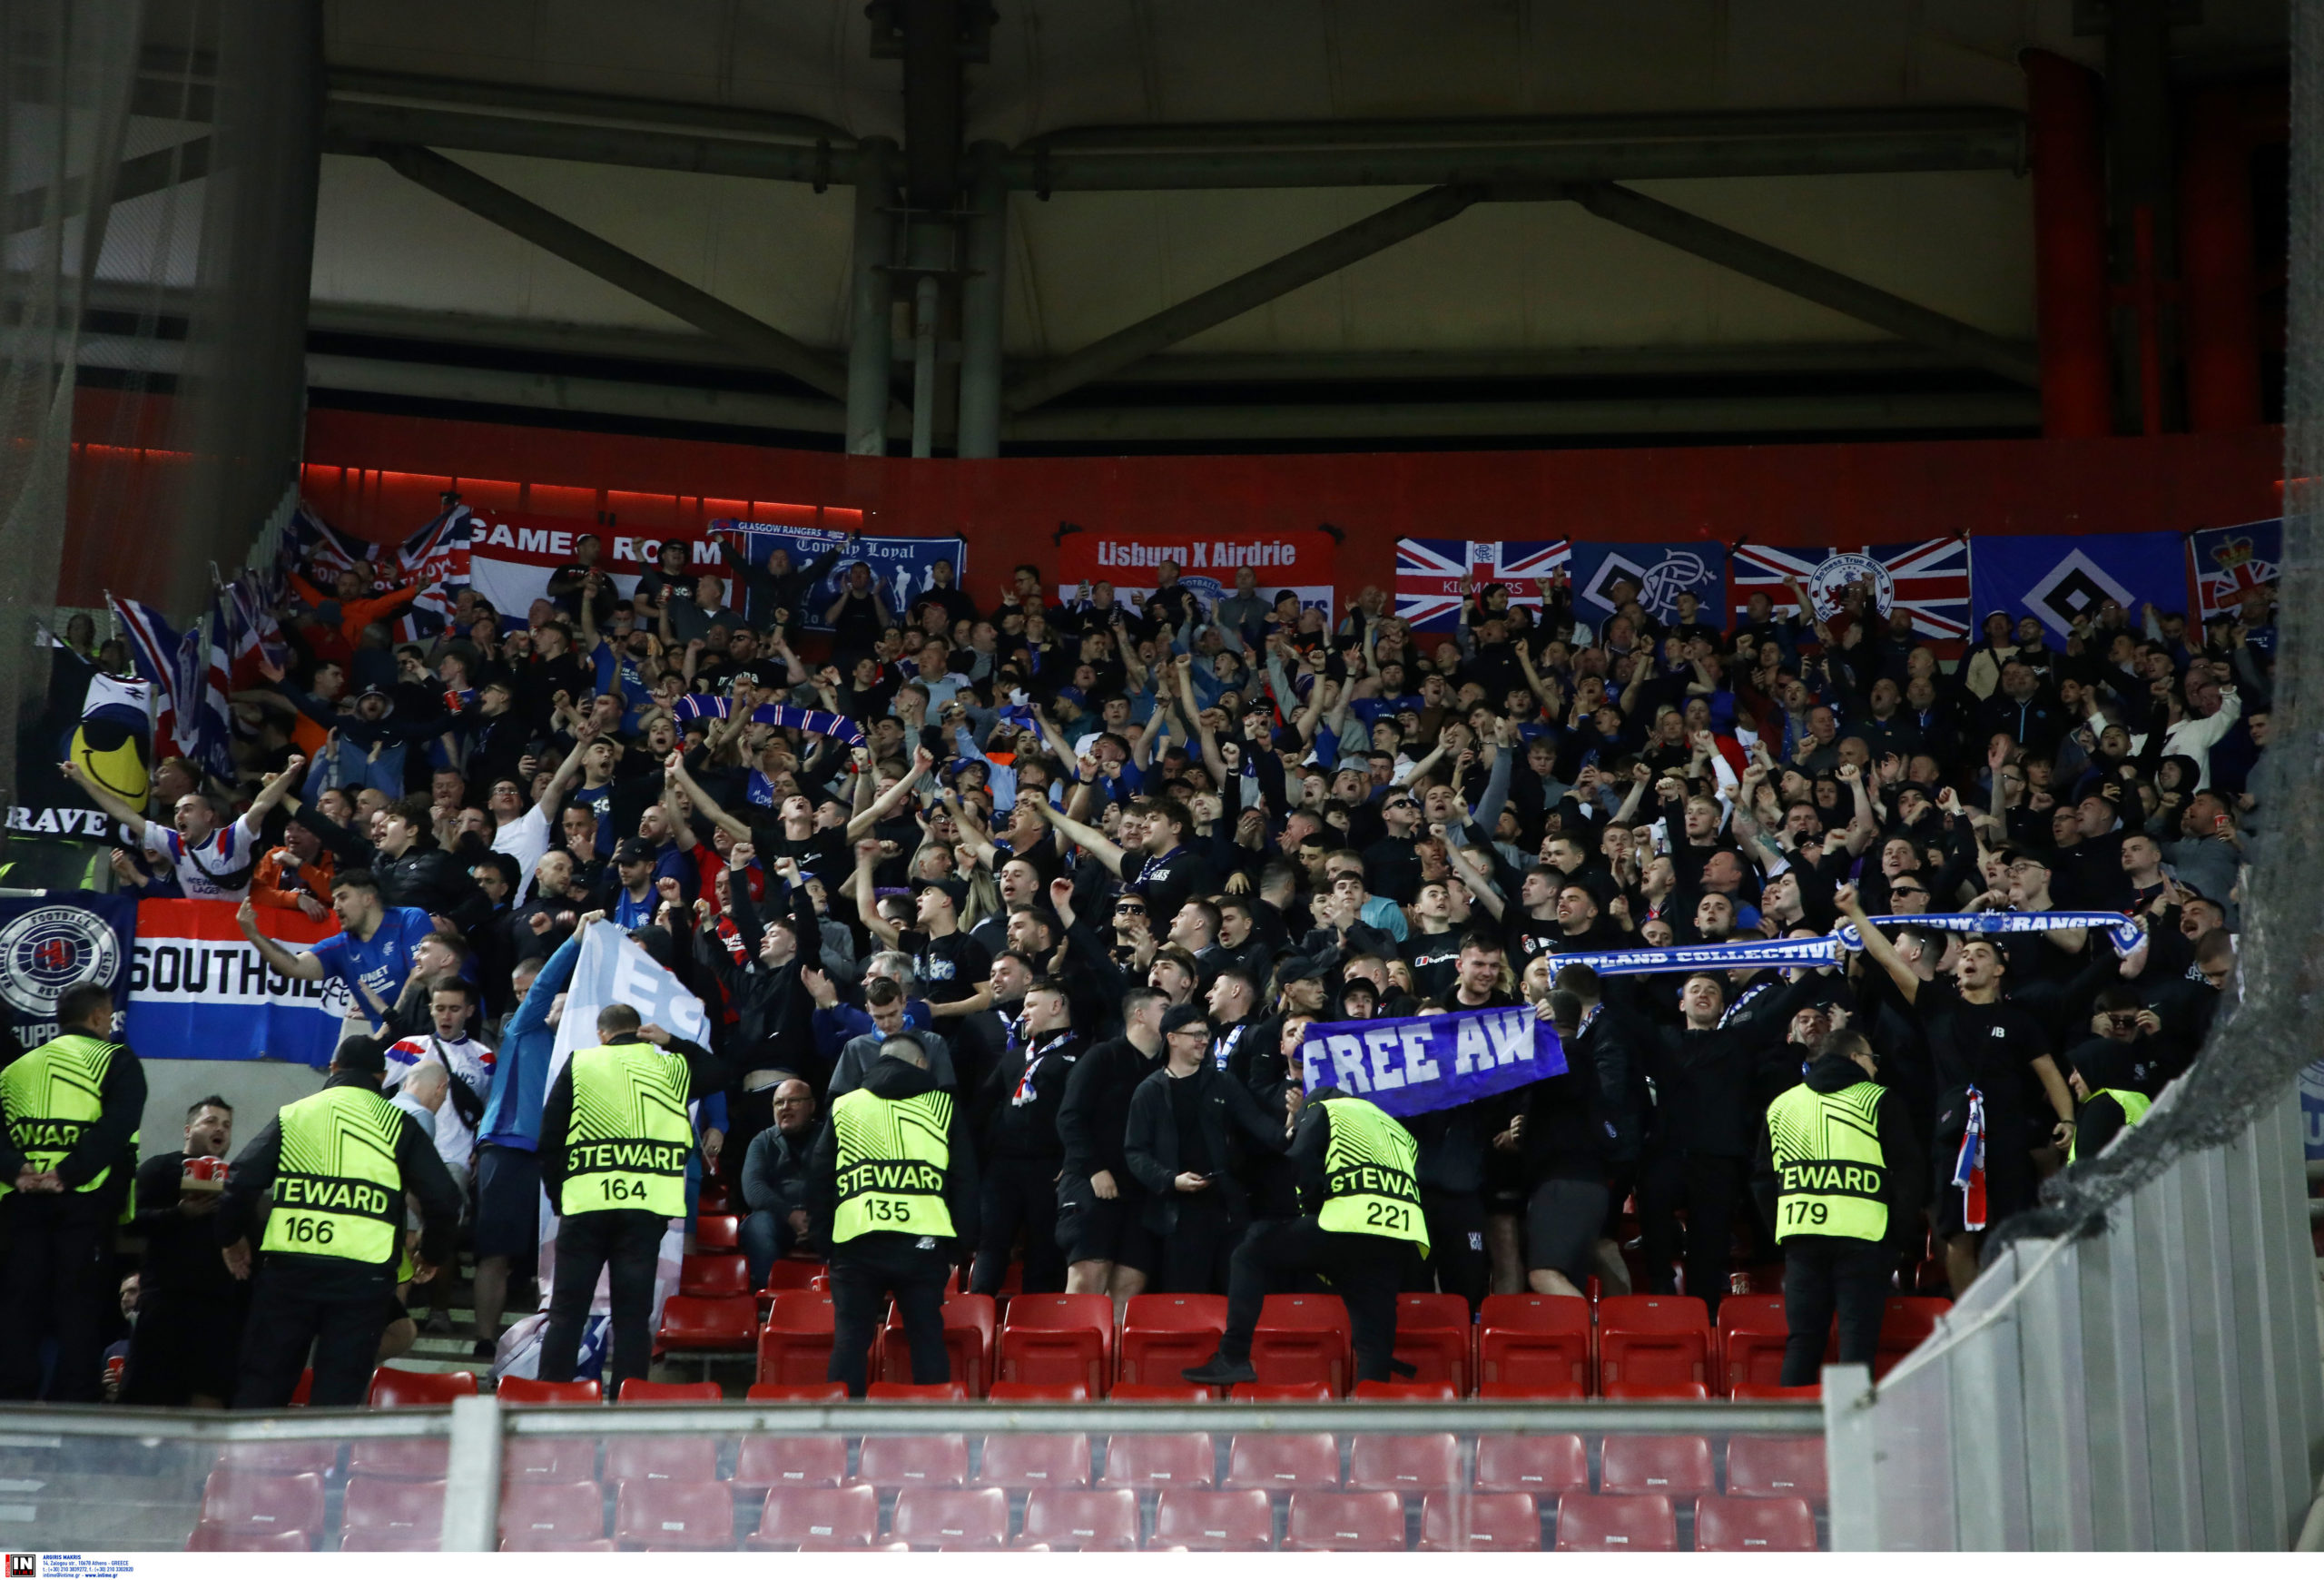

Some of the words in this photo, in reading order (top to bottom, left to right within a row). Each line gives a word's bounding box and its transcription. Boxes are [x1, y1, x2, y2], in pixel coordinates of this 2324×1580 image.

[738, 521, 781, 534] GLASGOW
[783, 525, 822, 537] RANGERS
[613, 536, 721, 565] ROM
[866, 541, 914, 561] Loyal
[1097, 540, 1187, 567] Lisburn
[1192, 542, 1208, 568] X
[1212, 540, 1296, 567] Airdrie
[1815, 558, 1842, 581] Bo'ness
[1845, 556, 1866, 565] True
[1866, 560, 1885, 579] Blues
[1443, 580, 1523, 595] KIMRS
[31, 912, 91, 928] FOOTBALL
[98, 952, 113, 979] CLUB
[1303, 1022, 1440, 1096] FREE
[1455, 1008, 1535, 1075] AW
[567, 1144, 685, 1171] STEWARD
[600, 1179, 647, 1200] 164
[836, 1164, 943, 1198] STEWARD
[1330, 1167, 1421, 1203] STEWA
[1779, 1165, 1881, 1194] EWARD
[273, 1177, 389, 1214] TEWARD
[865, 1199, 911, 1222] 135
[1366, 1201, 1410, 1232] 221
[1786, 1200, 1828, 1225] 179
[285, 1216, 335, 1244] 166
